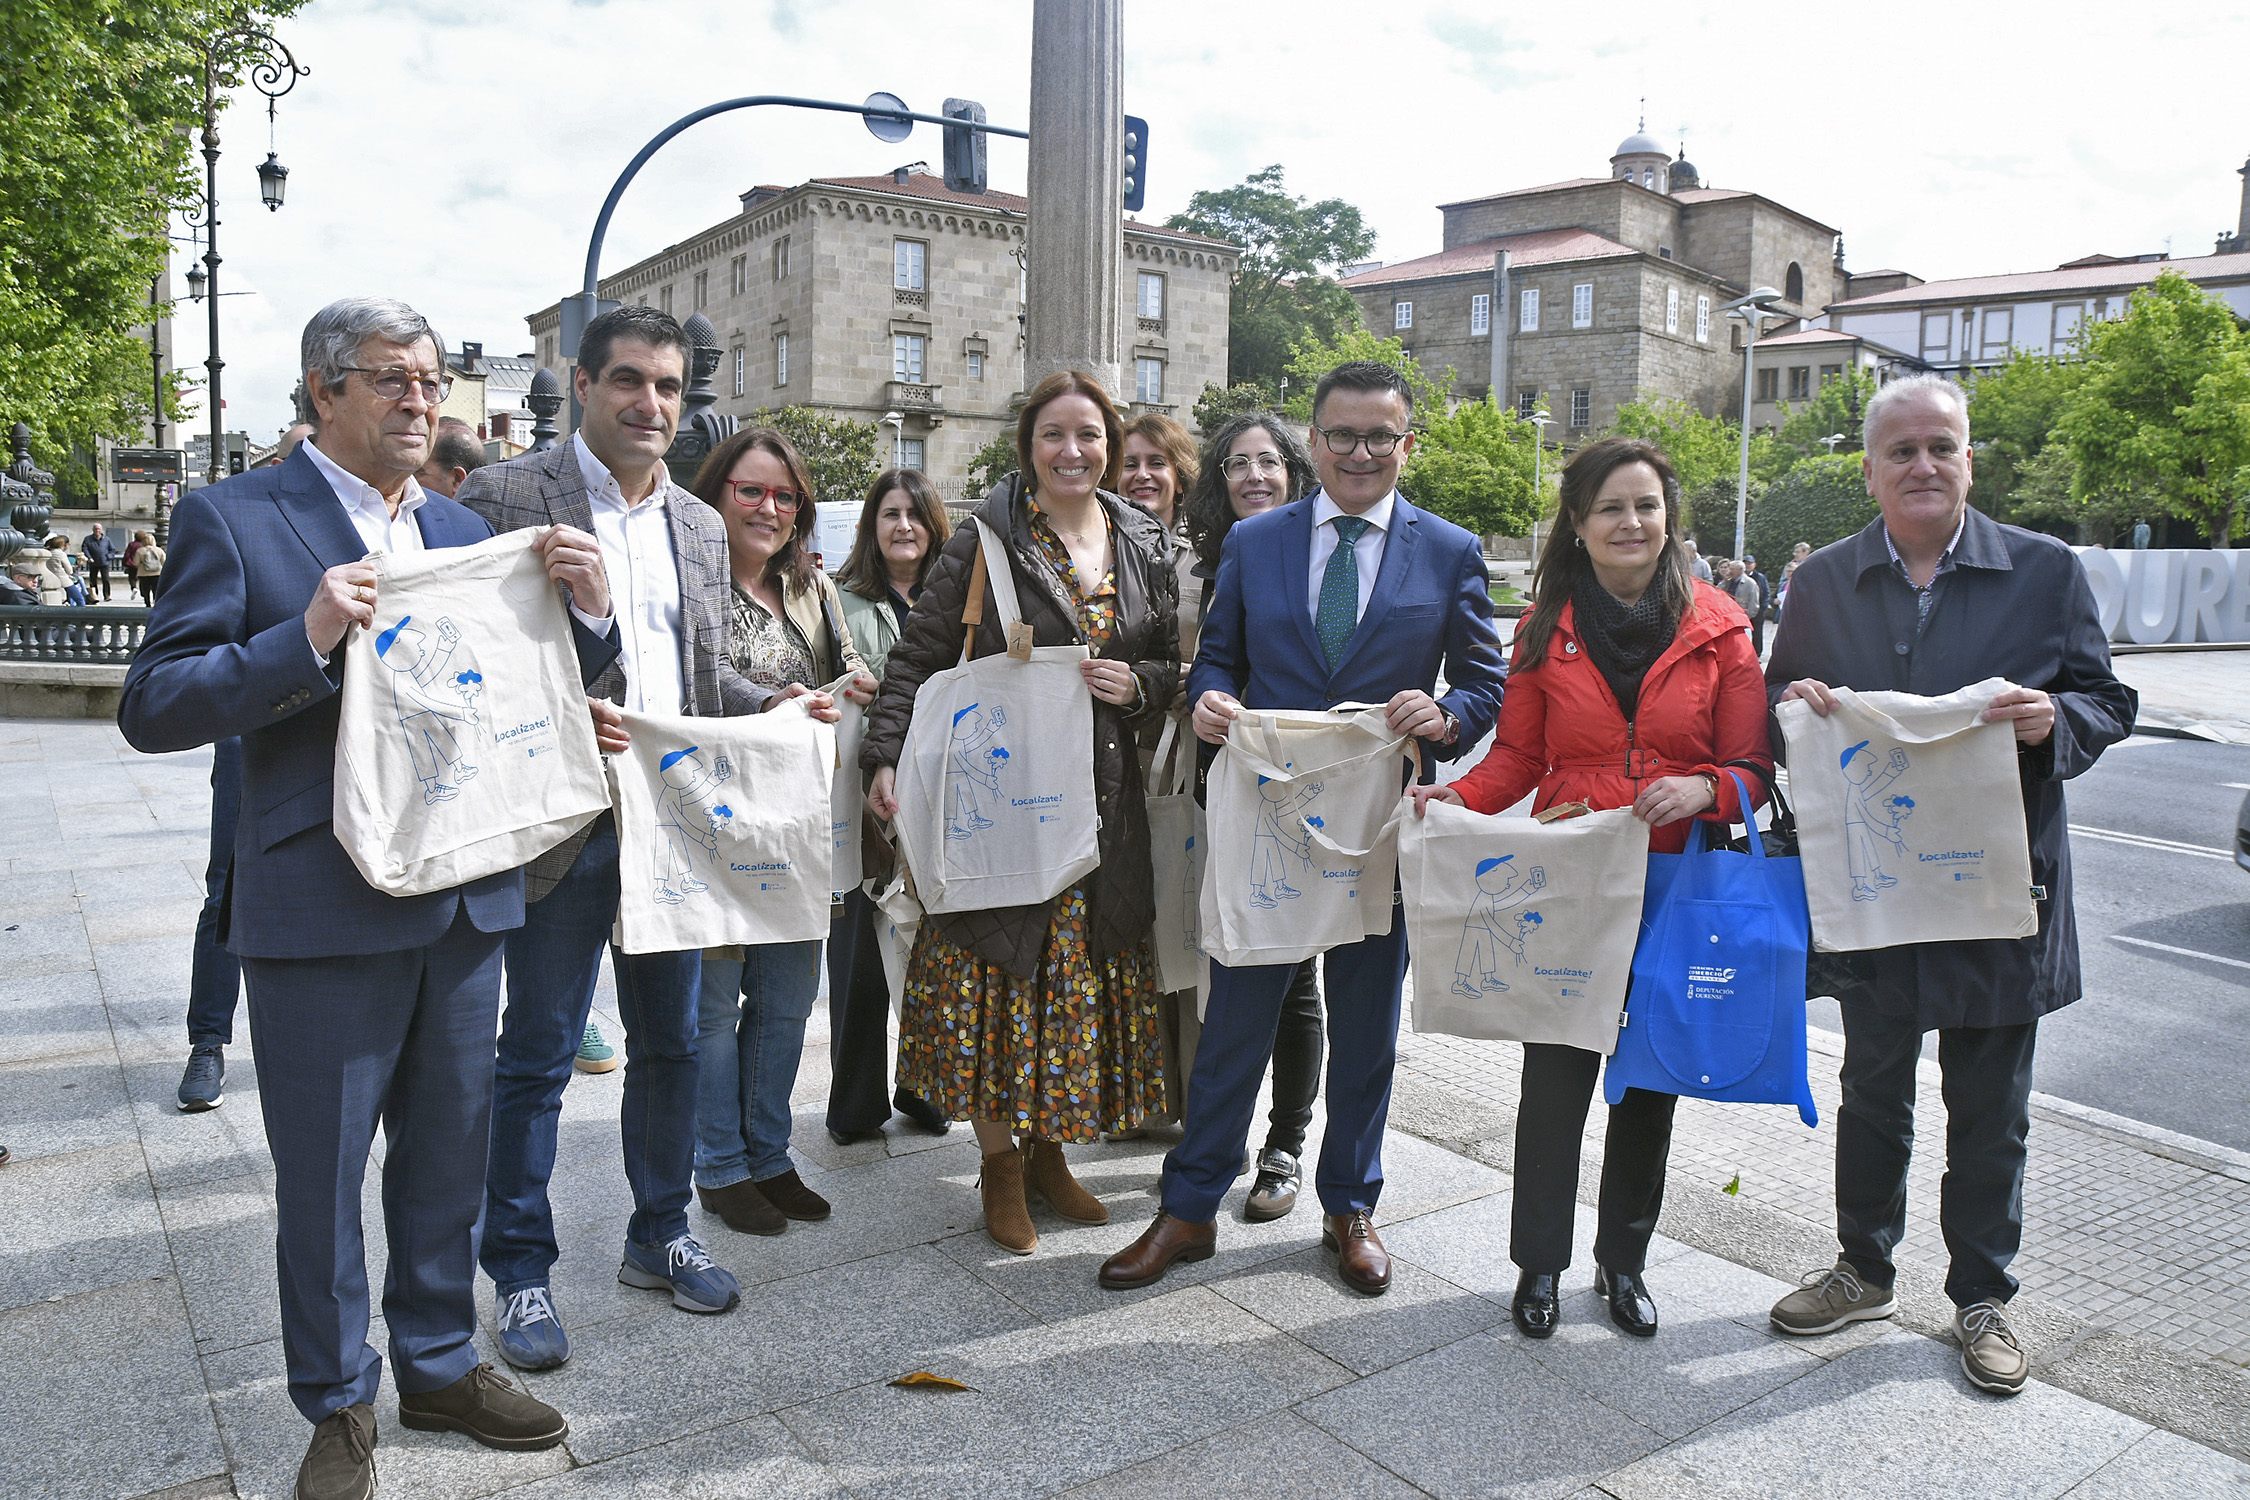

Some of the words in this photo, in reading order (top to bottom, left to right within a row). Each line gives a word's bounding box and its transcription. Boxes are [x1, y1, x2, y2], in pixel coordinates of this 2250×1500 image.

[494, 715, 550, 744] Localízate!
[1011, 793, 1063, 807] Localízate!
[1918, 849, 1984, 862] Localízate!
[730, 860, 792, 871] Localízate!
[1534, 966, 1593, 979] Localízate!
[1695, 987, 1735, 995] DEPUTACIÓN
